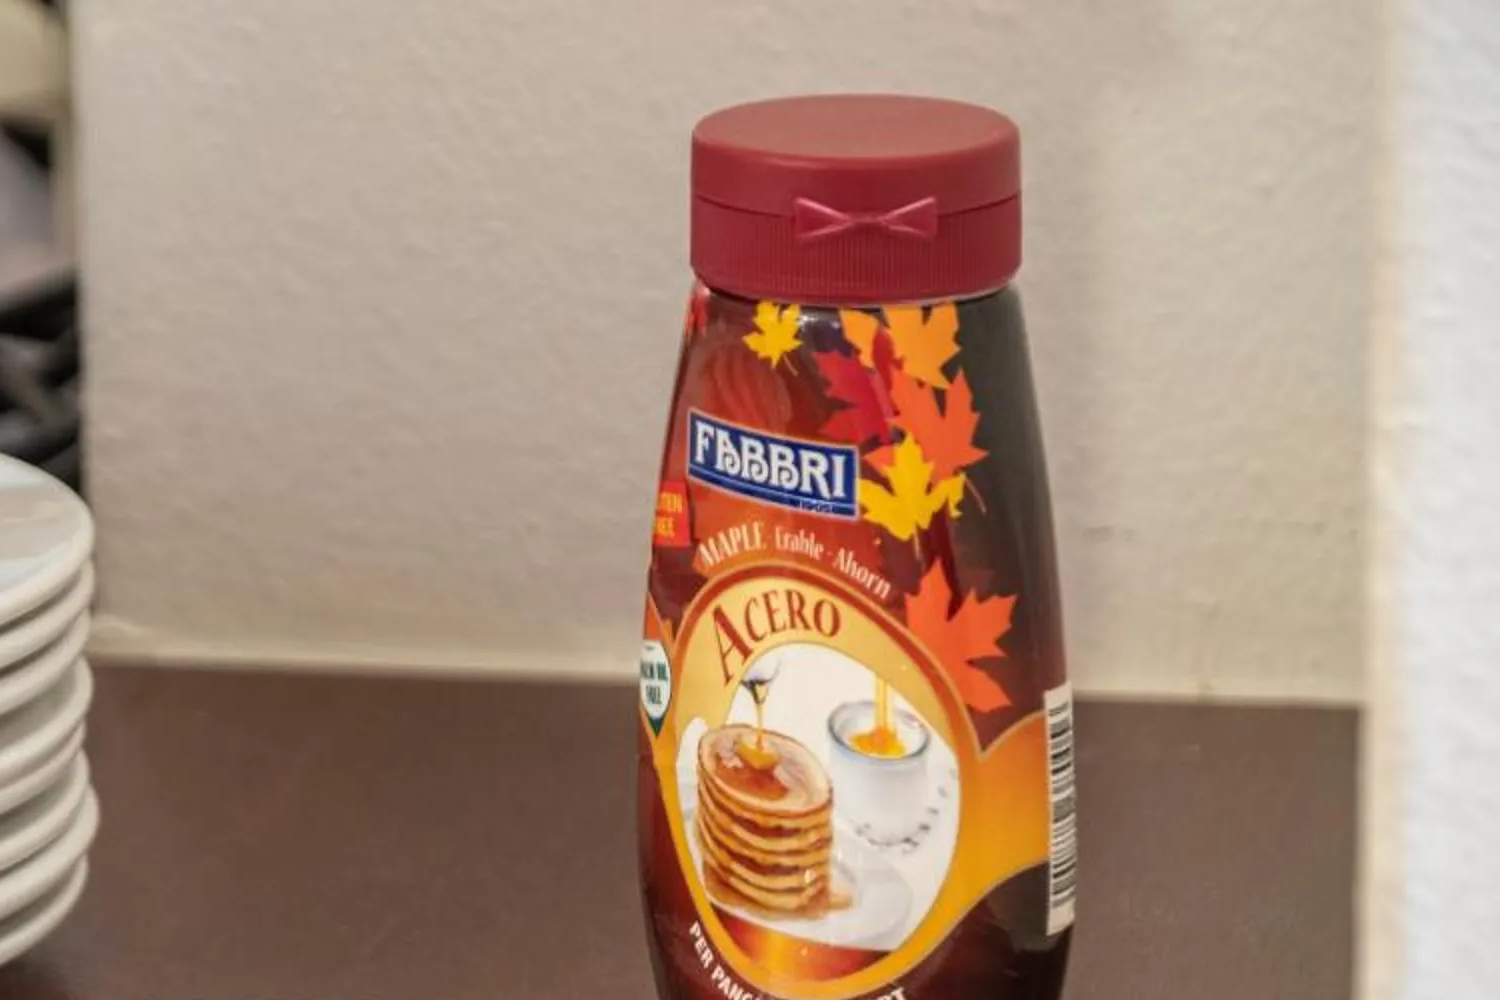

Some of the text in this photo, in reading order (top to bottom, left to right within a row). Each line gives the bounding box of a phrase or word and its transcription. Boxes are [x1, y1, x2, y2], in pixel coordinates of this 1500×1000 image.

[695, 420, 846, 499] FABBRI
[698, 521, 765, 567] MAPLE
[832, 547, 892, 600] Ahorn
[712, 588, 841, 685] ACERO
[689, 920, 714, 968] PER
